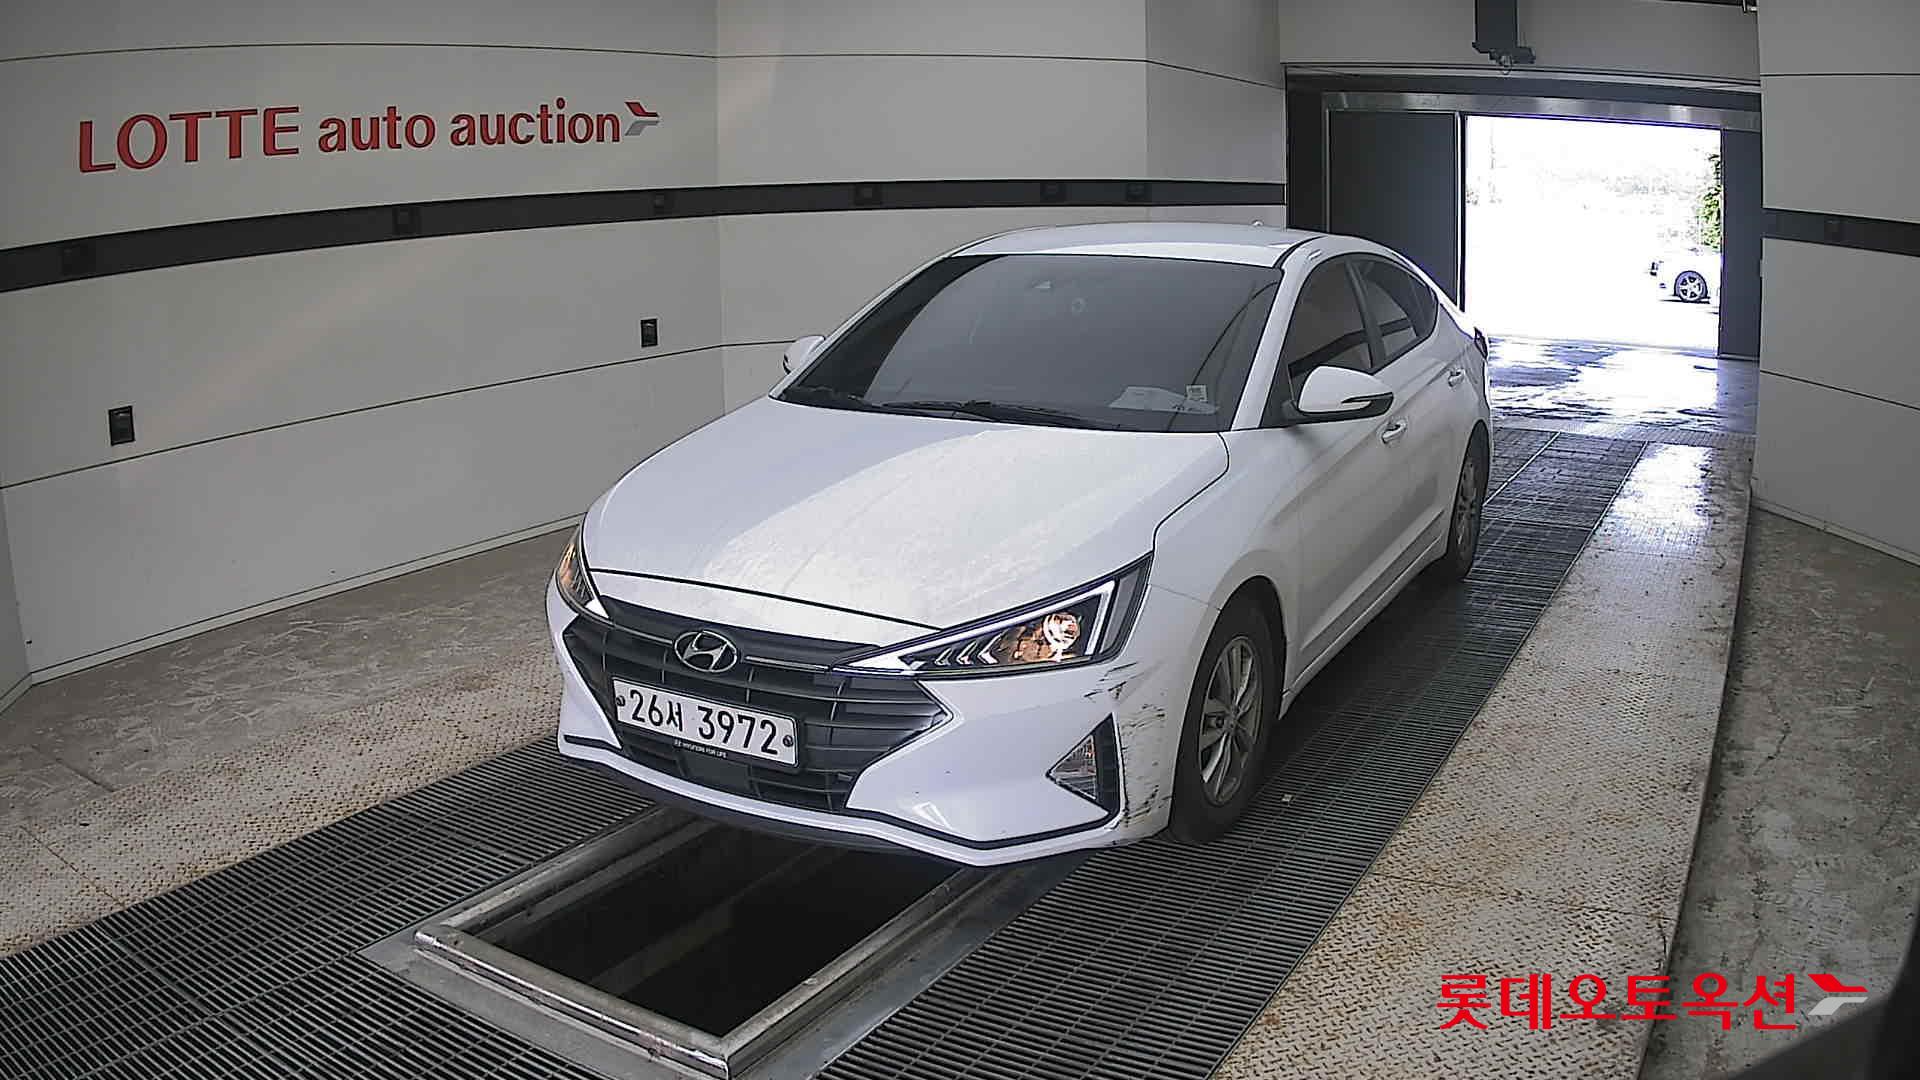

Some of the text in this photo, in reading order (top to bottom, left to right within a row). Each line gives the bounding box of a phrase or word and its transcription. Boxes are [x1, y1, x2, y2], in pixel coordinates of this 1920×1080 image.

[79, 98, 621, 173] LOTTE auto auction
[630, 690, 778, 755] 26서 3972
